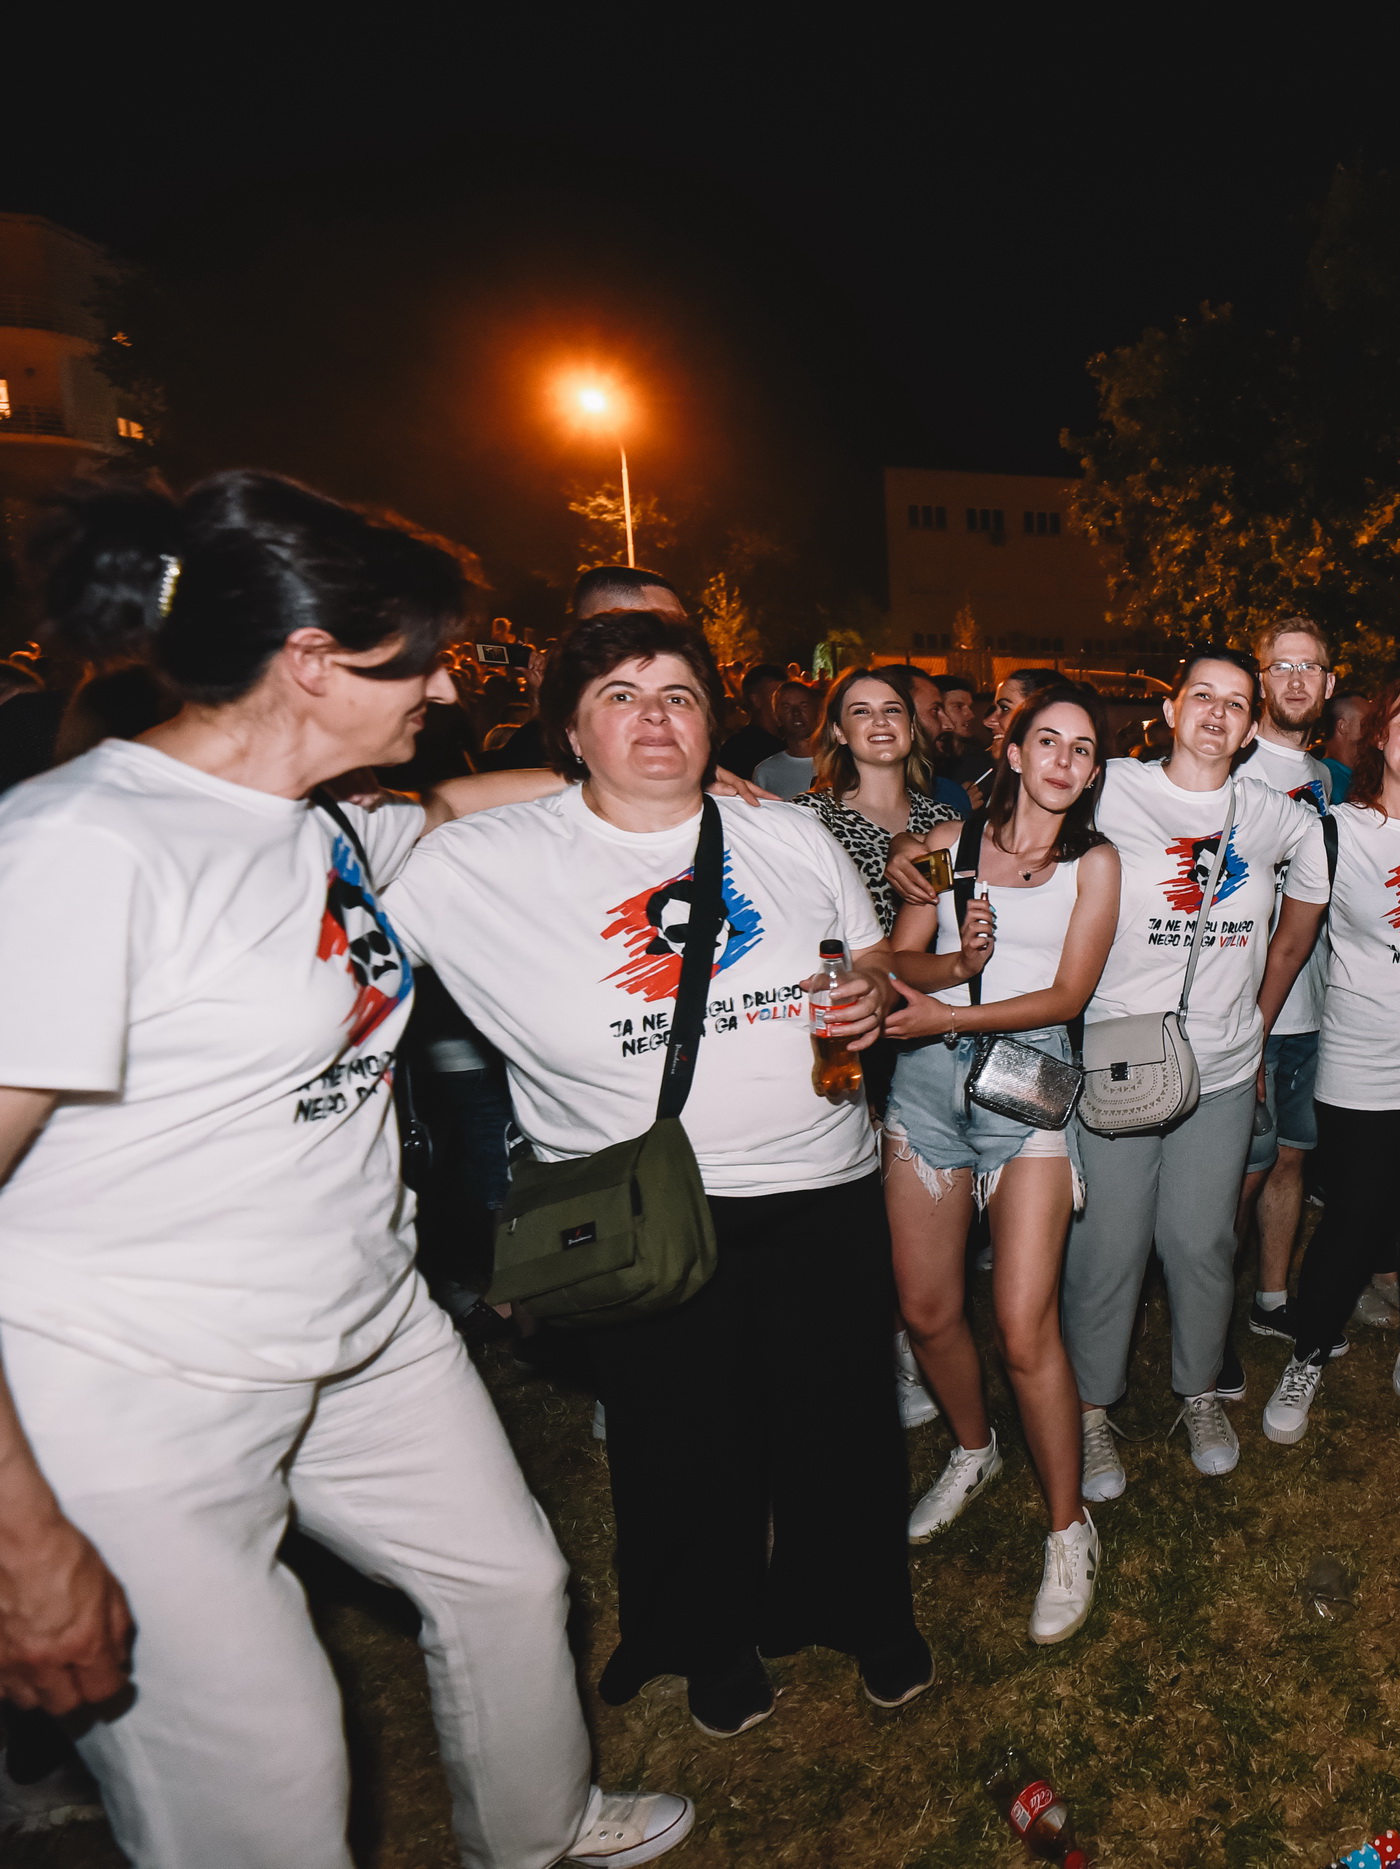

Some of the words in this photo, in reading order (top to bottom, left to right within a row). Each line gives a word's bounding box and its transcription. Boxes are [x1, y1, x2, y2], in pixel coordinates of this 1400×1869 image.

[1147, 918, 1163, 931] JA
[1164, 919, 1182, 932] NE
[1184, 920, 1218, 934] MGU
[1220, 920, 1255, 934] DRUGO
[1147, 932, 1182, 947] NEGO
[1200, 935, 1217, 948] GA
[1219, 934, 1250, 949] VOLIN
[609, 1018, 633, 1038] JA
[641, 1012, 670, 1033] NE
[708, 996, 735, 1018] GU
[742, 983, 804, 1010] DRUGO
[714, 1014, 739, 1034] GA
[745, 1002, 803, 1026] VOLIN
[1030, 1788, 1053, 1817] Cola
